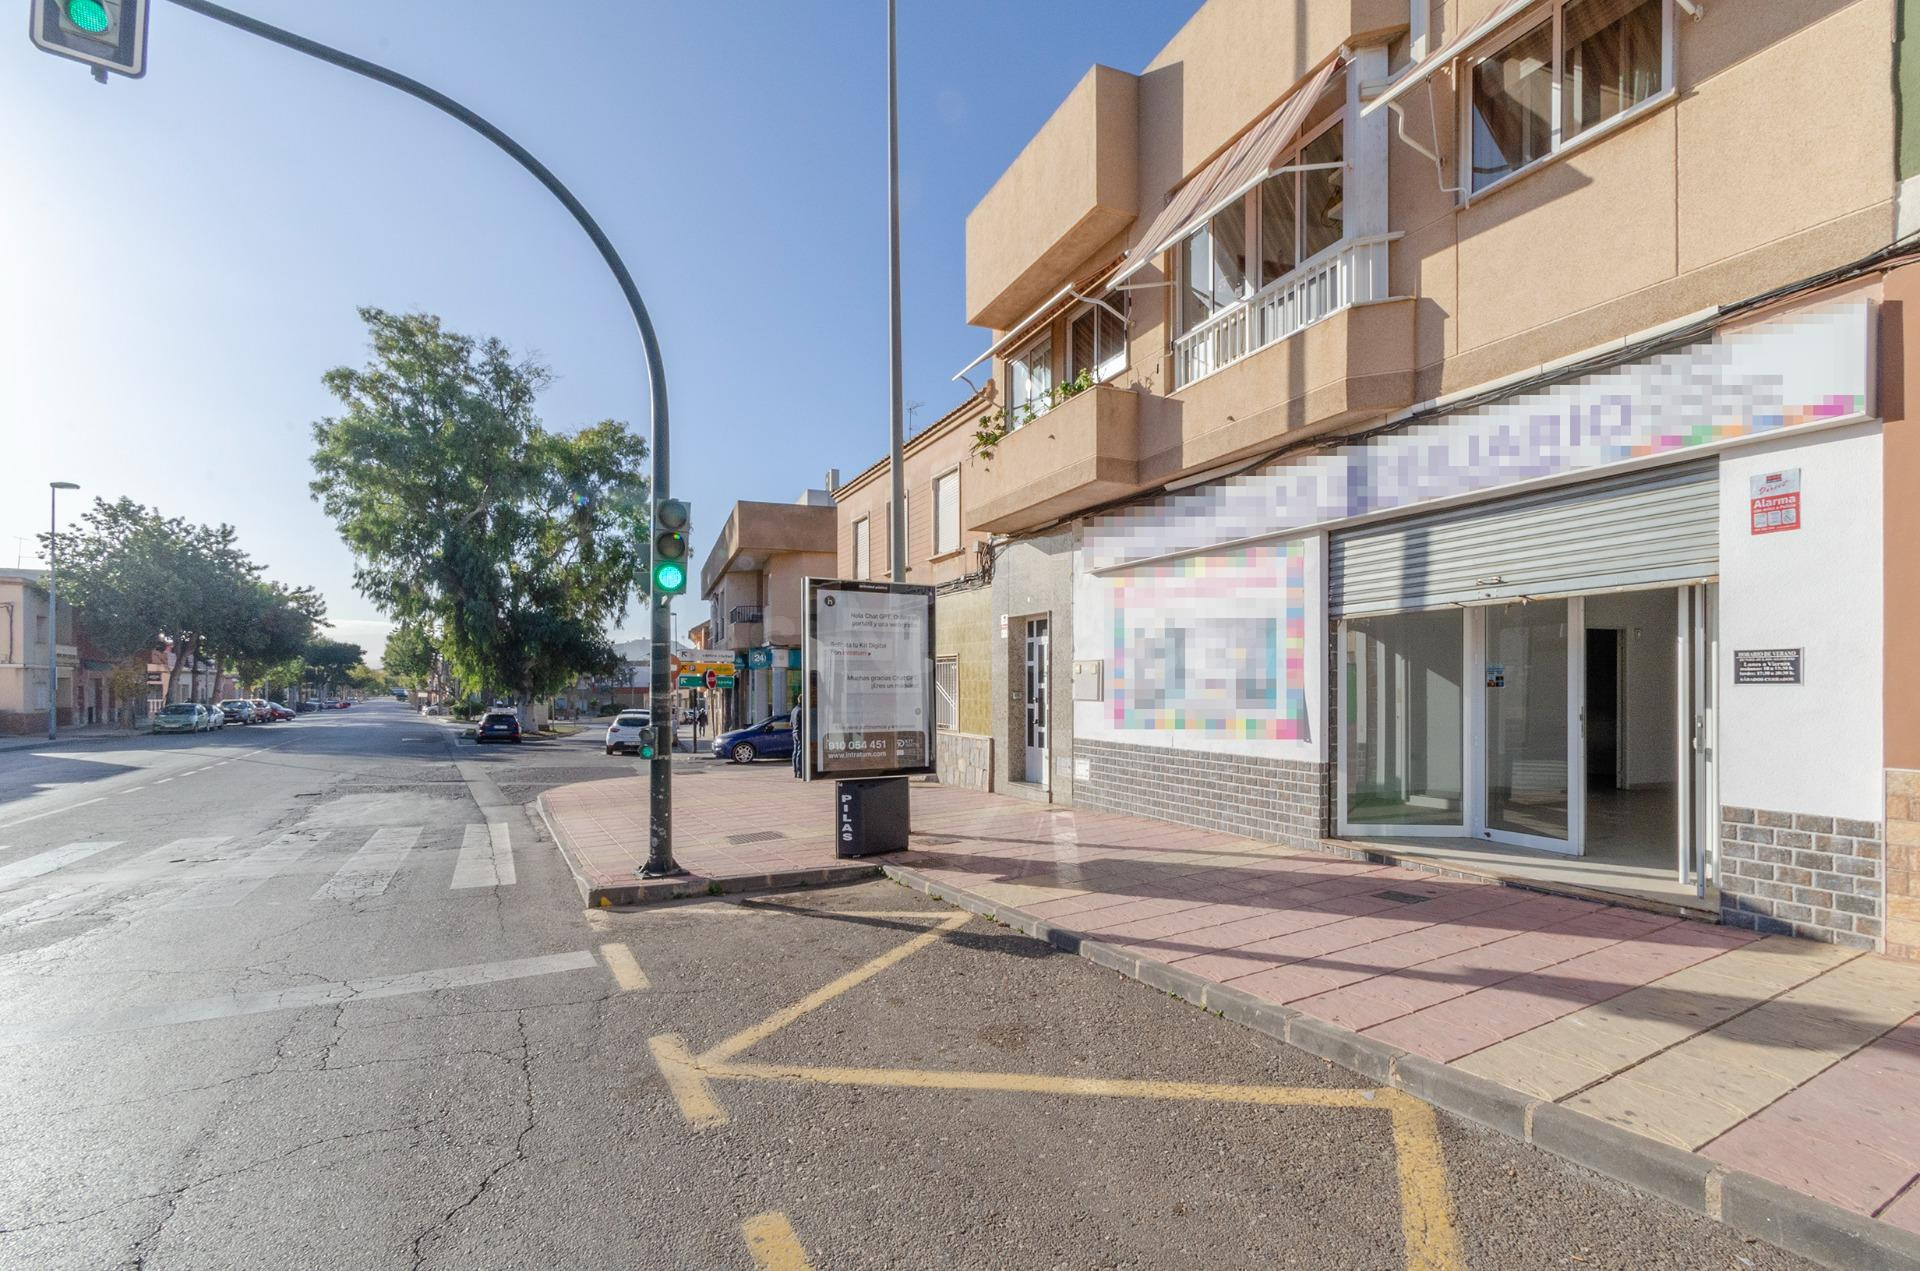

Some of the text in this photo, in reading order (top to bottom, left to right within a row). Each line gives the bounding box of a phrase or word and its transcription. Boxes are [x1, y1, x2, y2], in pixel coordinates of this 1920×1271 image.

[1753, 496, 1796, 509] Alarma
[828, 740, 886, 750] 910 054 451
[841, 794, 853, 841] PILAS
